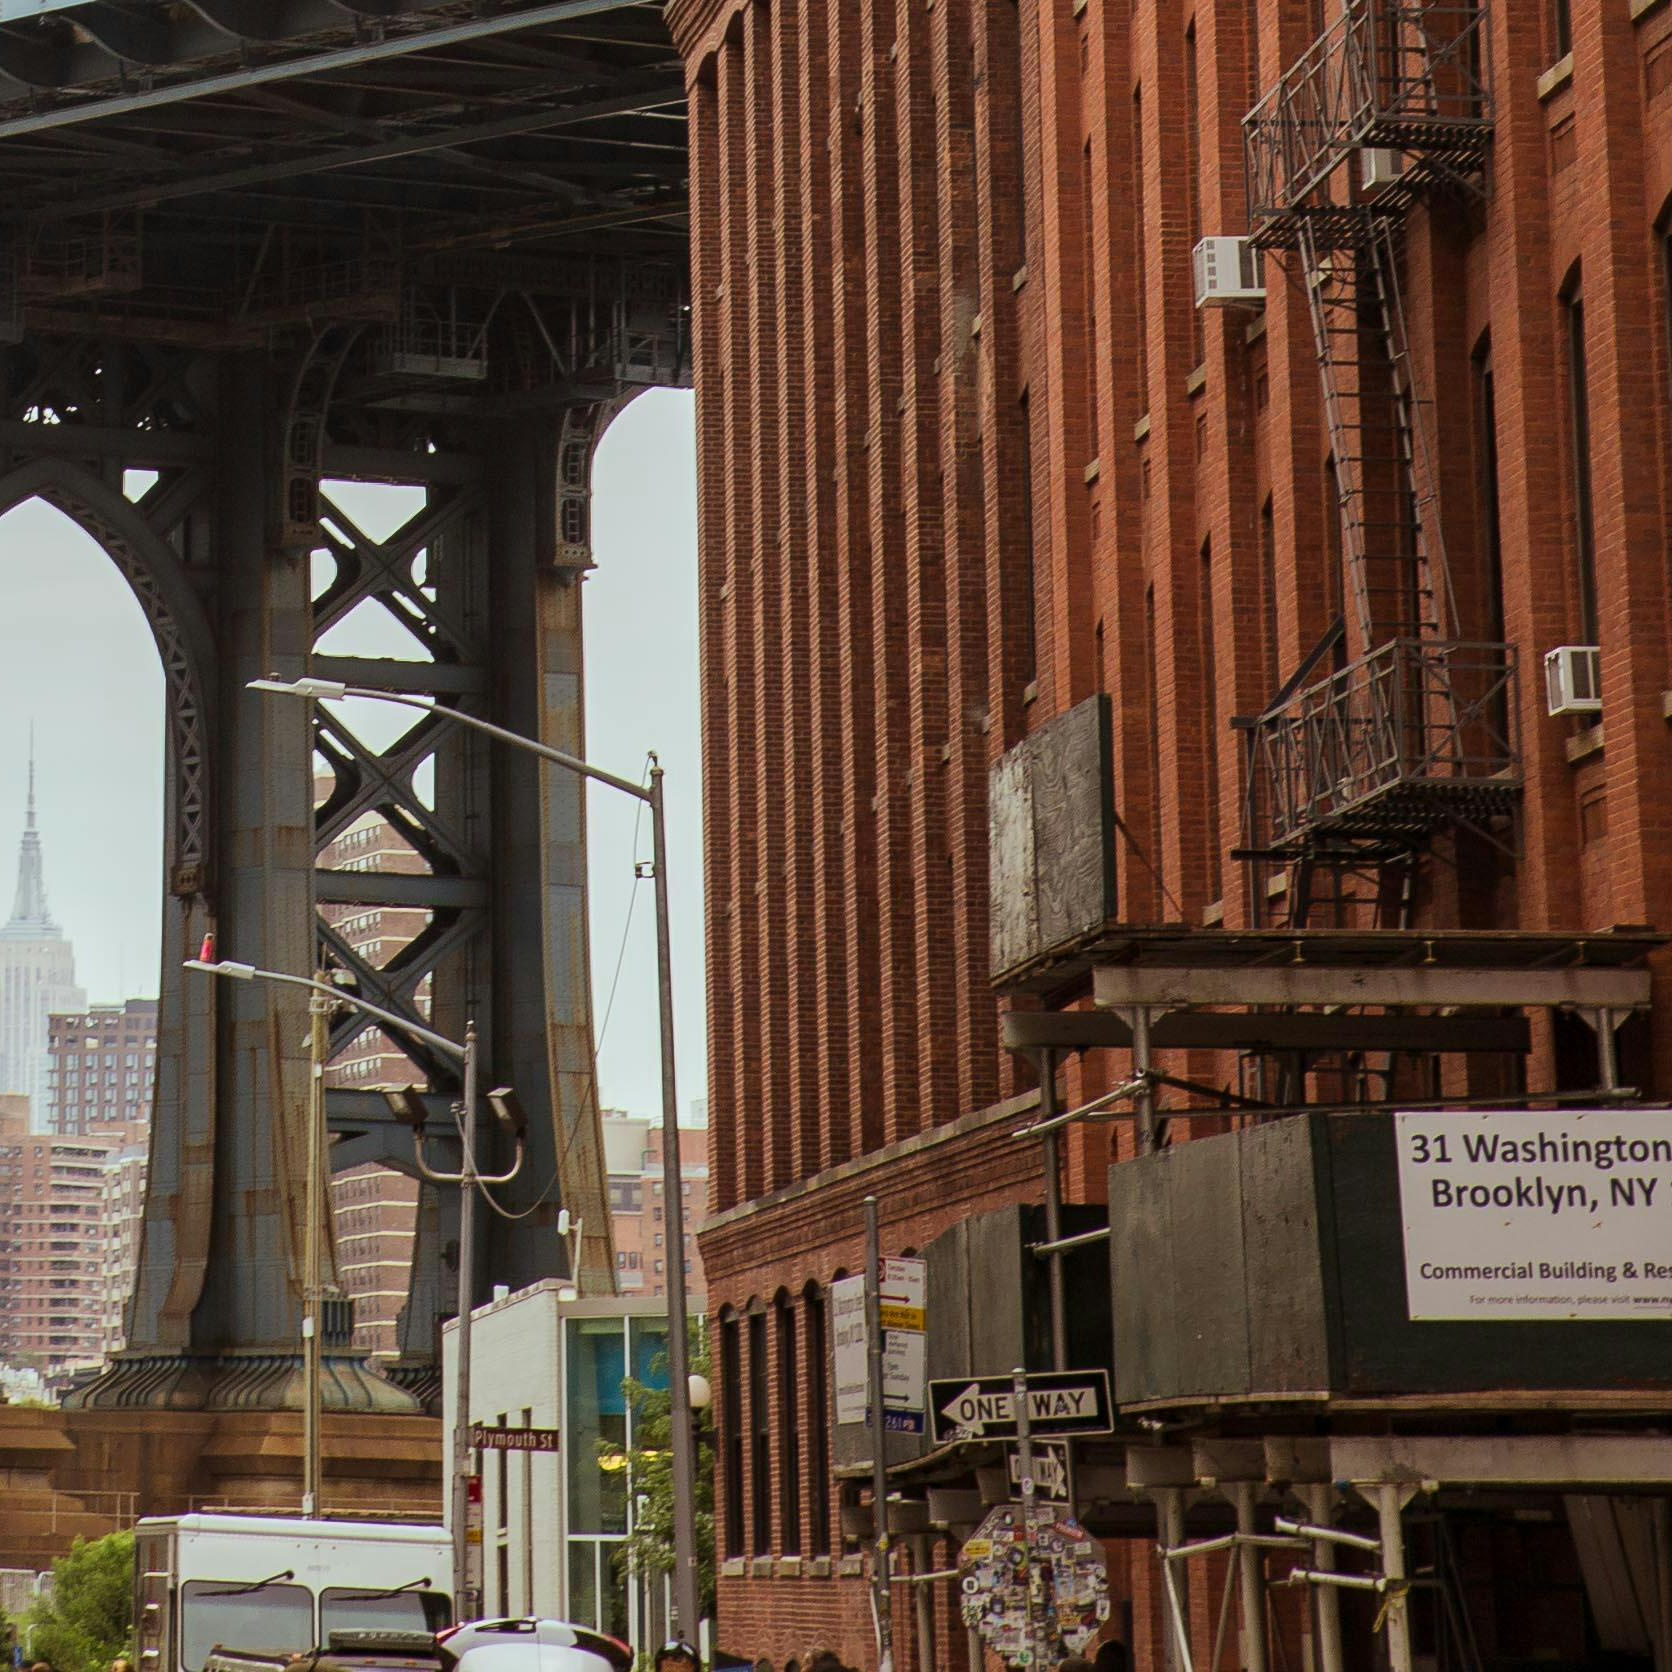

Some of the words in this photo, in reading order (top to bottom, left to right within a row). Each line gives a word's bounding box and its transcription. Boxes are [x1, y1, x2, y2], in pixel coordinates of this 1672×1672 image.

[1411, 1134, 1453, 1163] 31
[1463, 1132, 1672, 1170] Washington
[1431, 1176, 1598, 1214] Brooklyn,
[1610, 1178, 1658, 1206] NY
[1420, 1262, 1534, 1280] Commercial
[1539, 1262, 1617, 1282] Building
[1622, 1262, 1639, 1280] &
[1470, 1295, 1486, 1304] For
[1489, 1296, 1514, 1304] more
[1578, 1294, 1609, 1306] please
[960, 1396, 1010, 1422] ONE
[1032, 1391, 1086, 1417] WAY
[475, 1430, 537, 1448] Plymouth
[540, 1433, 553, 1448] St
